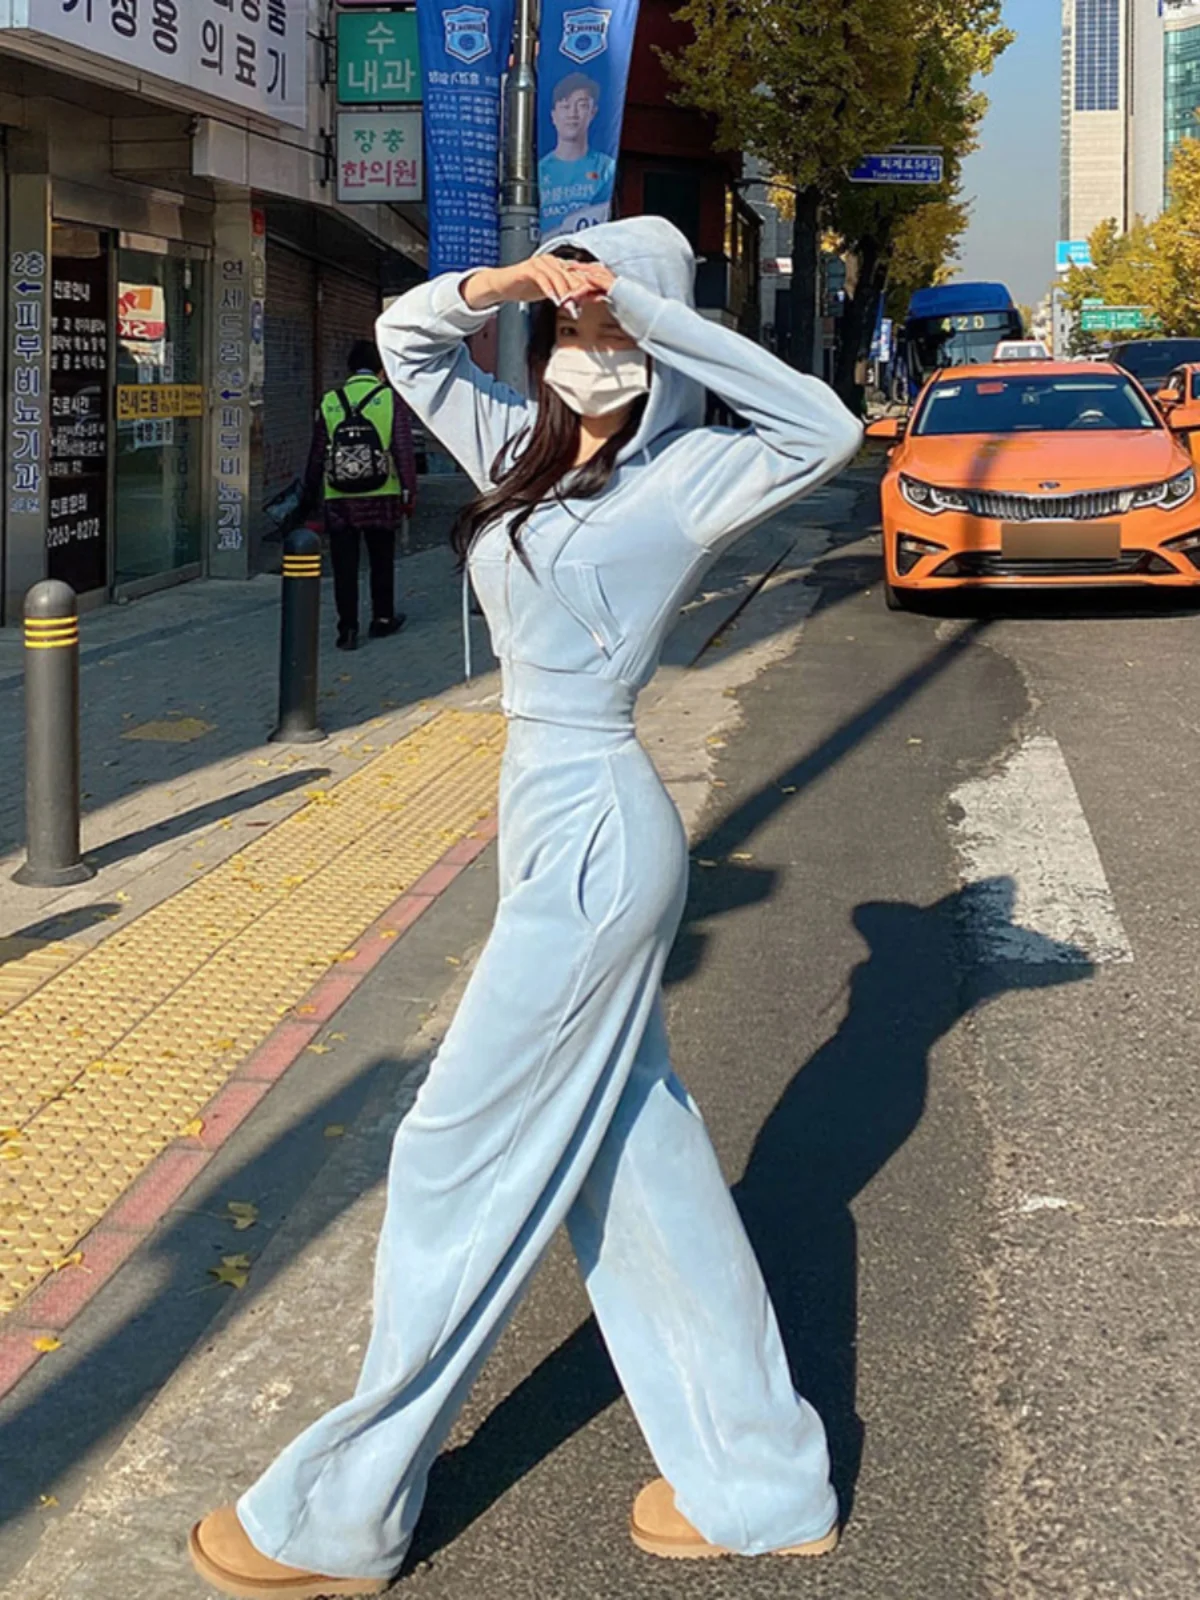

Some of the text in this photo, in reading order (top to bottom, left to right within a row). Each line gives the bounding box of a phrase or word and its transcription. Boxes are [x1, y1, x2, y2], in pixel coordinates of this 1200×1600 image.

[366, 21, 396, 55] 수
[201, 20, 286, 100] 의료기
[348, 59, 416, 94] 내과
[342, 160, 417, 188] 한의원
[12, 252, 44, 275] 2층
[941, 314, 985, 331] 420
[13, 301, 42, 491] 피부비뇨기과
